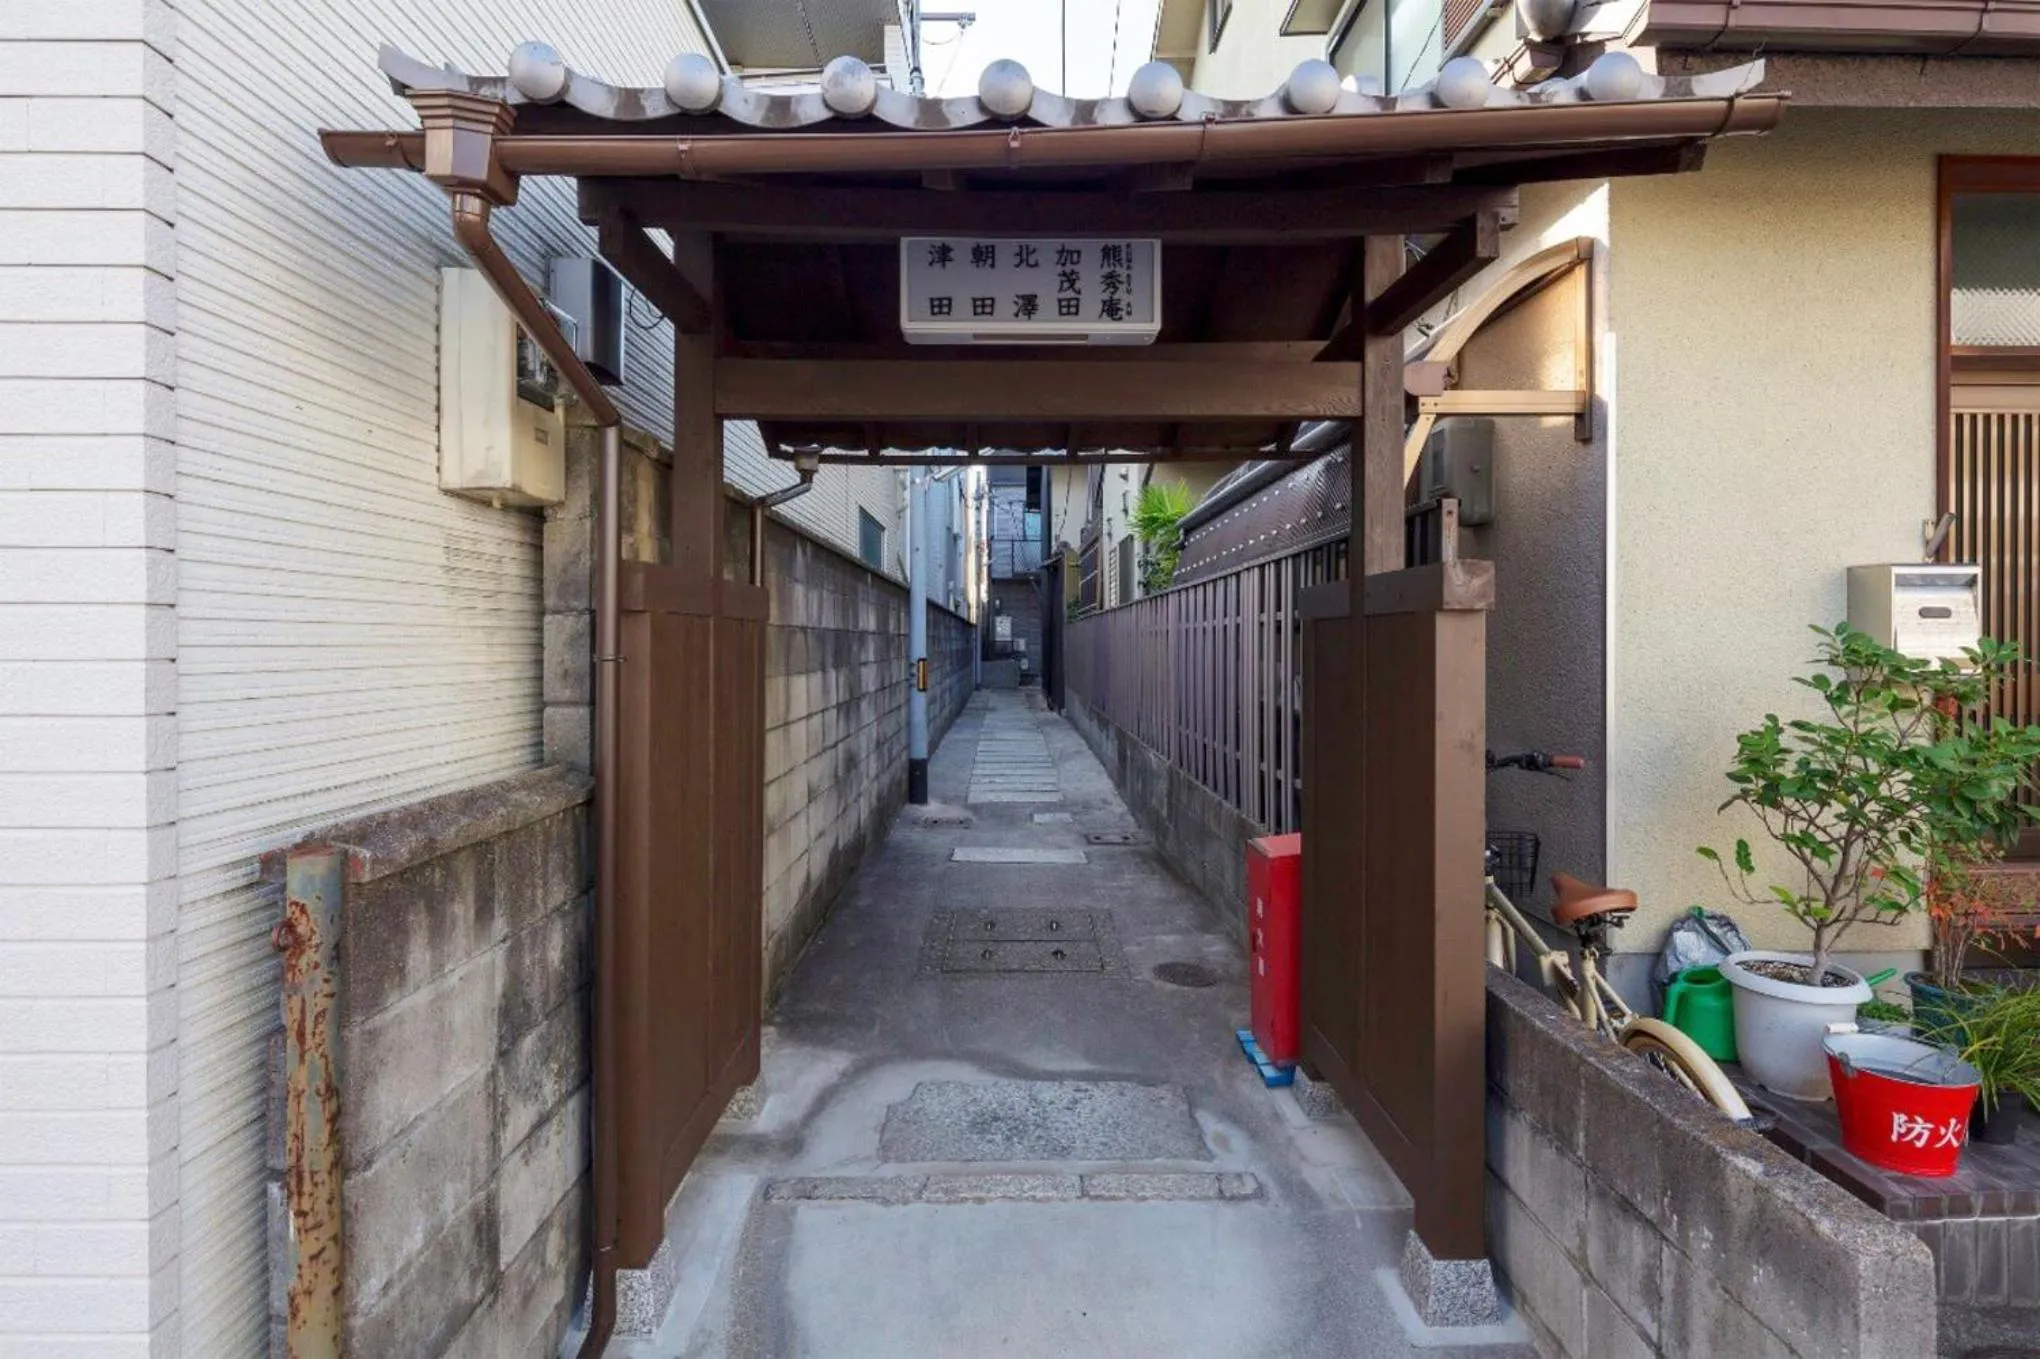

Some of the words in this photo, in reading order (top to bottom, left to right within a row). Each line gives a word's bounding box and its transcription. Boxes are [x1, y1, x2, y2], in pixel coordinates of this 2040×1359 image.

[928, 243, 954, 317] 津田
[970, 243, 996, 318] 朝田
[1013, 243, 1040, 321] 北澤
[1055, 243, 1082, 317] 加茂田
[1890, 1111, 1969, 1149] 防火
